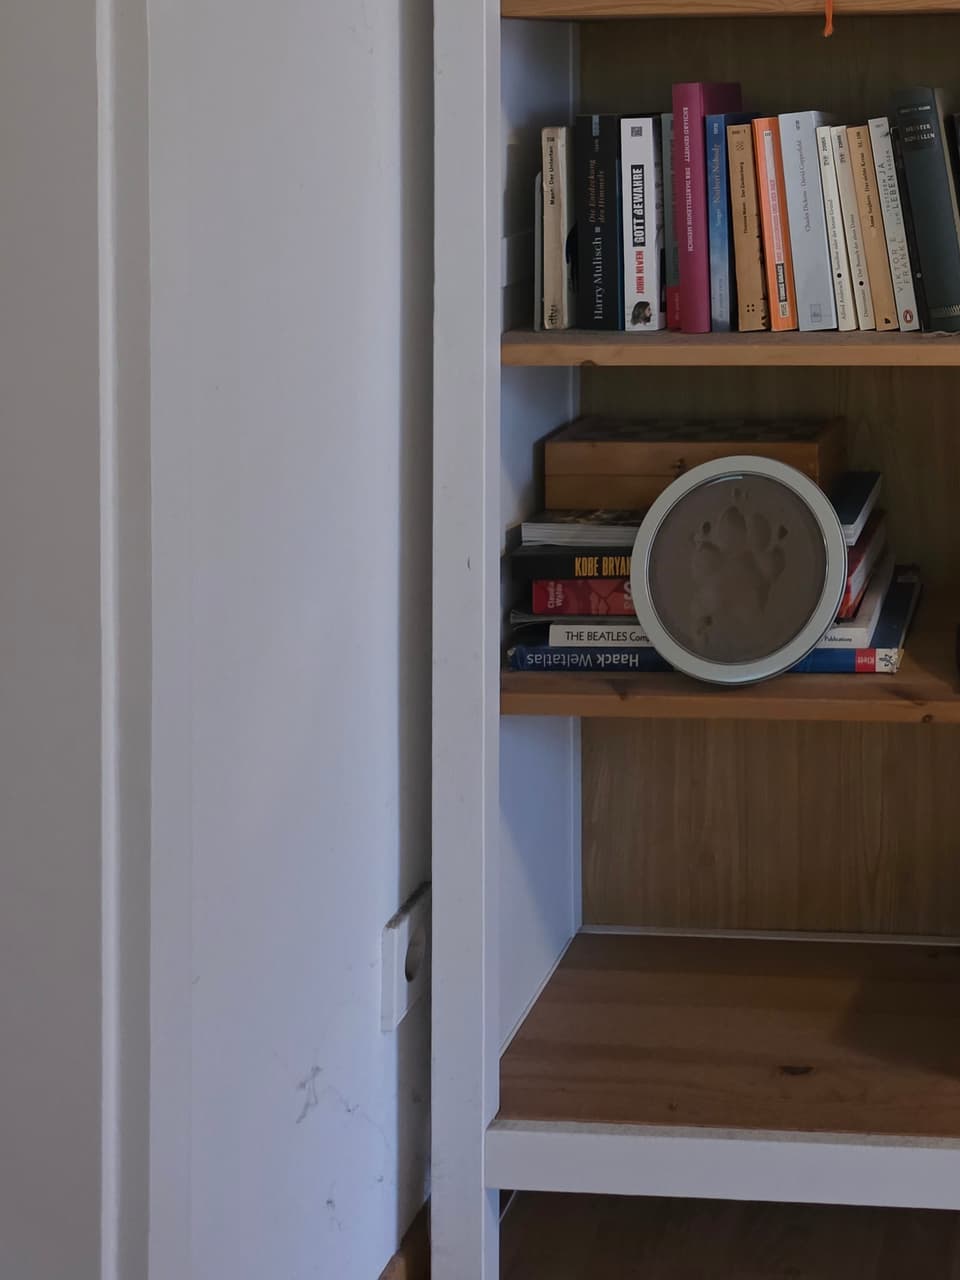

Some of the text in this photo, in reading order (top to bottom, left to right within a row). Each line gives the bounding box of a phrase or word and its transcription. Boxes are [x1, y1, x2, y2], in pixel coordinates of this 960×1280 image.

[631, 168, 646, 243] GOTT BEWAHRE
[591, 237, 604, 319] Harry Mulisch
[575, 556, 599, 576] KOBE
[566, 631, 627, 641] THE BEATLES
[527, 653, 639, 667] Haack Weltatlas
